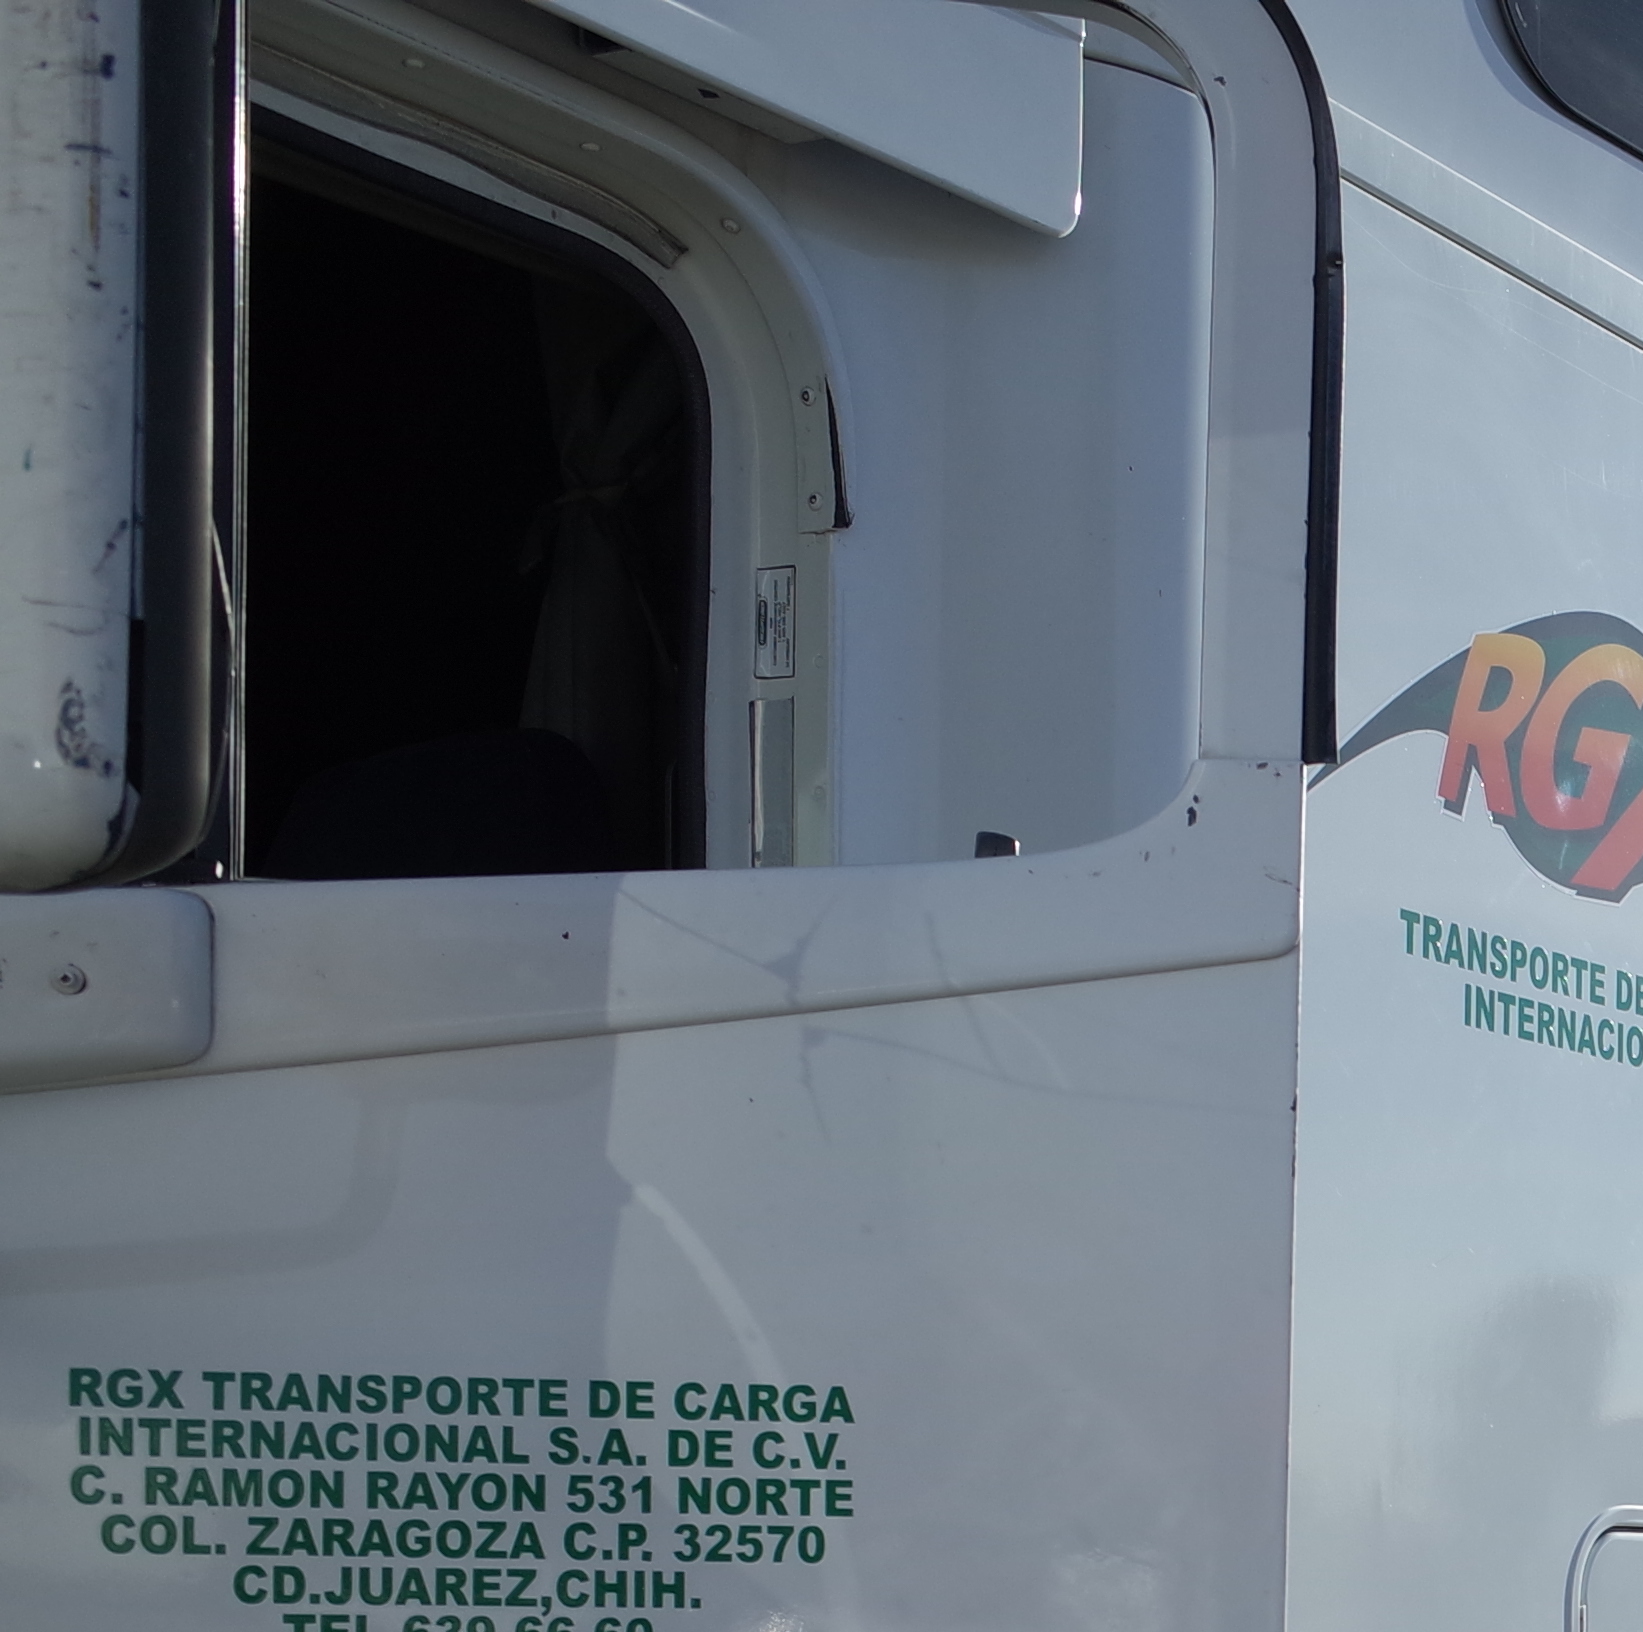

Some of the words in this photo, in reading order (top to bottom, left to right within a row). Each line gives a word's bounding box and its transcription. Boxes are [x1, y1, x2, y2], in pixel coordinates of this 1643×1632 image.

[1400, 907, 1607, 1008] TRANSPORTE
[68, 1367, 182, 1409] RGX
[201, 1370, 568, 1418] TRANSPORTE
[588, 1379, 655, 1420] DE
[674, 1381, 855, 1424] CARGA
[78, 1416, 529, 1465] INTERNACIONAL
[548, 1426, 647, 1467] S.A.
[667, 1429, 733, 1468] DE
[752, 1430, 847, 1470] C.V.
[70, 1464, 120, 1505] C.
[144, 1466, 344, 1509] RAMON
[366, 1470, 546, 1512] RAYON
[566, 1474, 653, 1515] 531
[678, 1476, 853, 1517] NORTE
[100, 1513, 225, 1555] COL.
[245, 1516, 545, 1560] ZARAGOZA
[563, 1521, 653, 1561] C.P.
[673, 1523, 826, 1564] 32570
[232, 1564, 702, 1615] CD.JUAREZ,CHIH.
